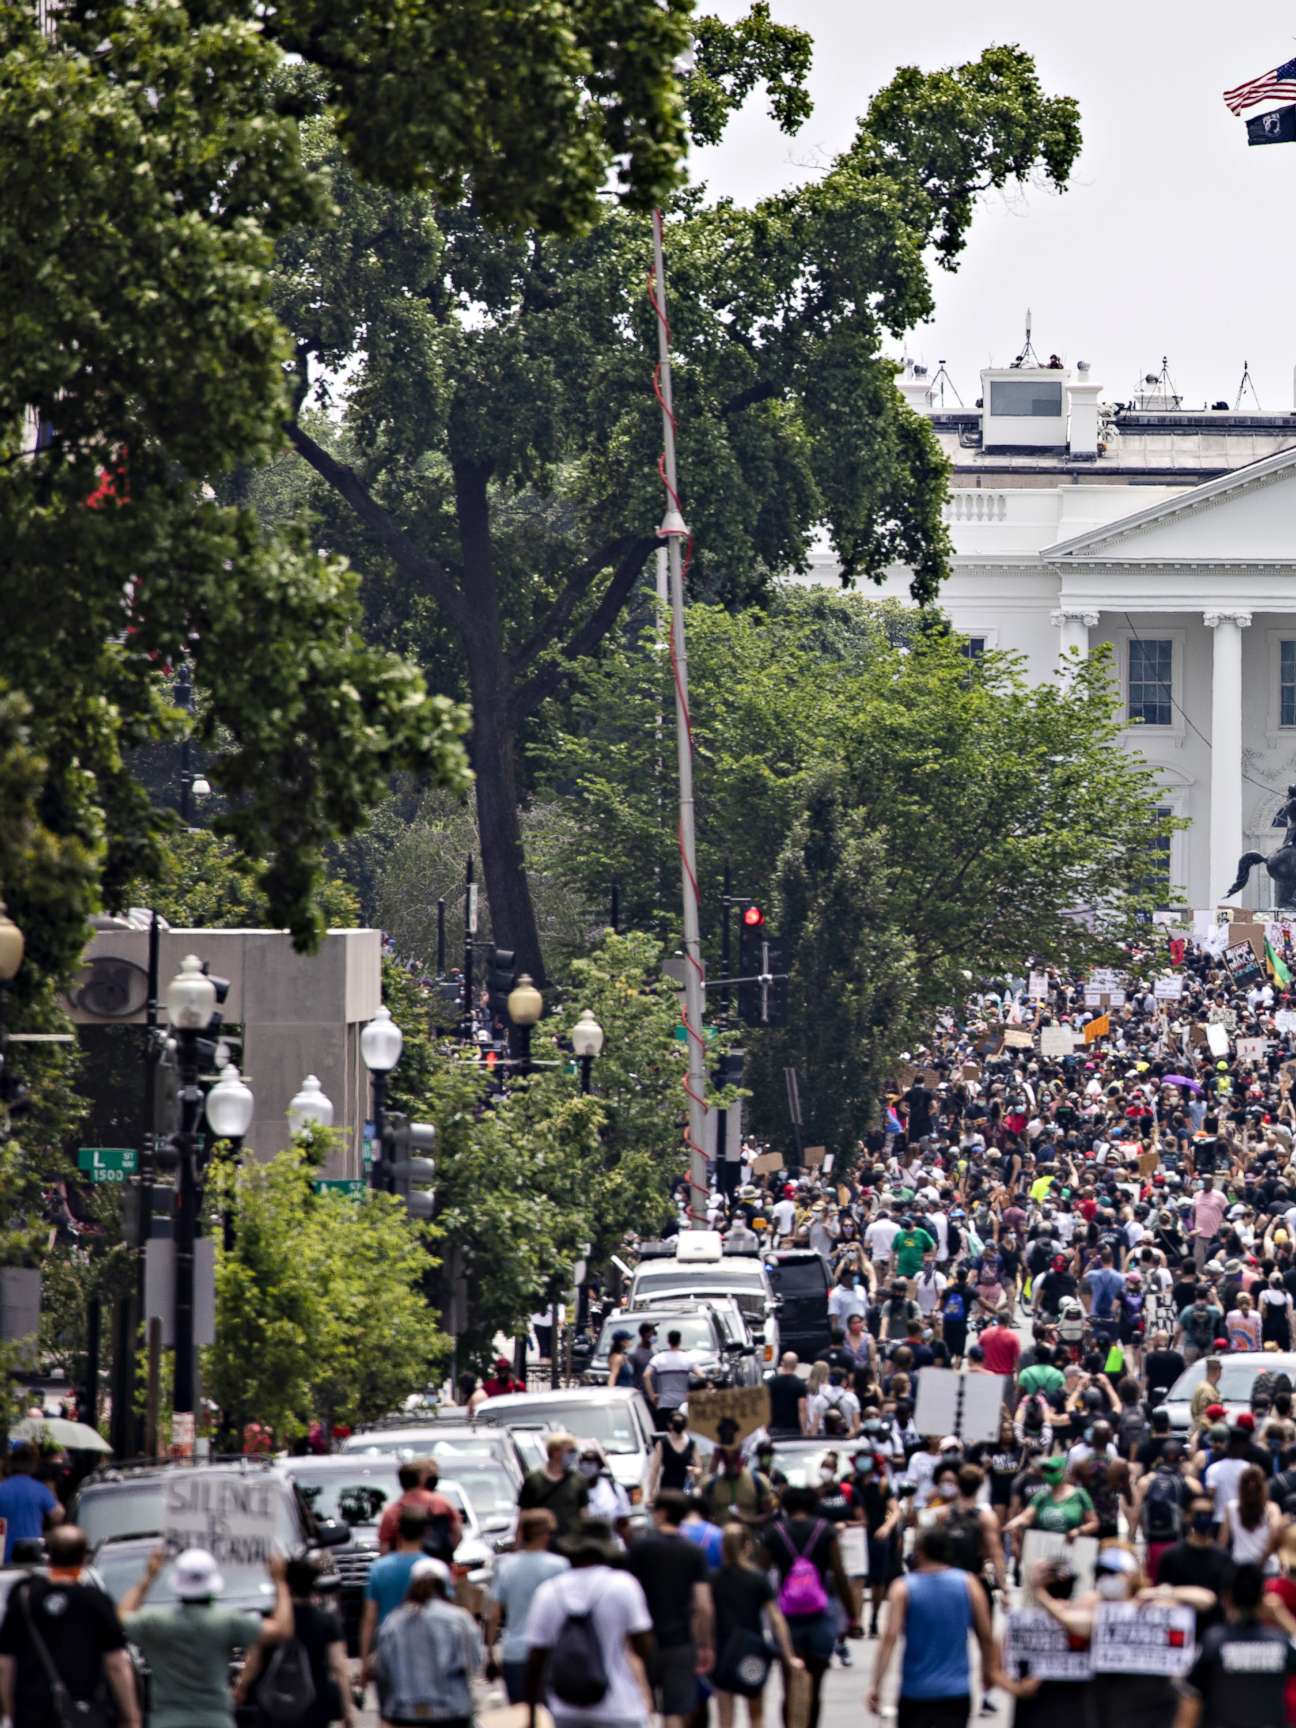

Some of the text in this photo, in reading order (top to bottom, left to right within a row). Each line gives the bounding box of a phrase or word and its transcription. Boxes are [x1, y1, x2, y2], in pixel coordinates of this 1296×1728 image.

[93, 1151, 106, 1168] L
[94, 1169, 124, 1182] 1500
[168, 1479, 272, 1518] SILENCE
